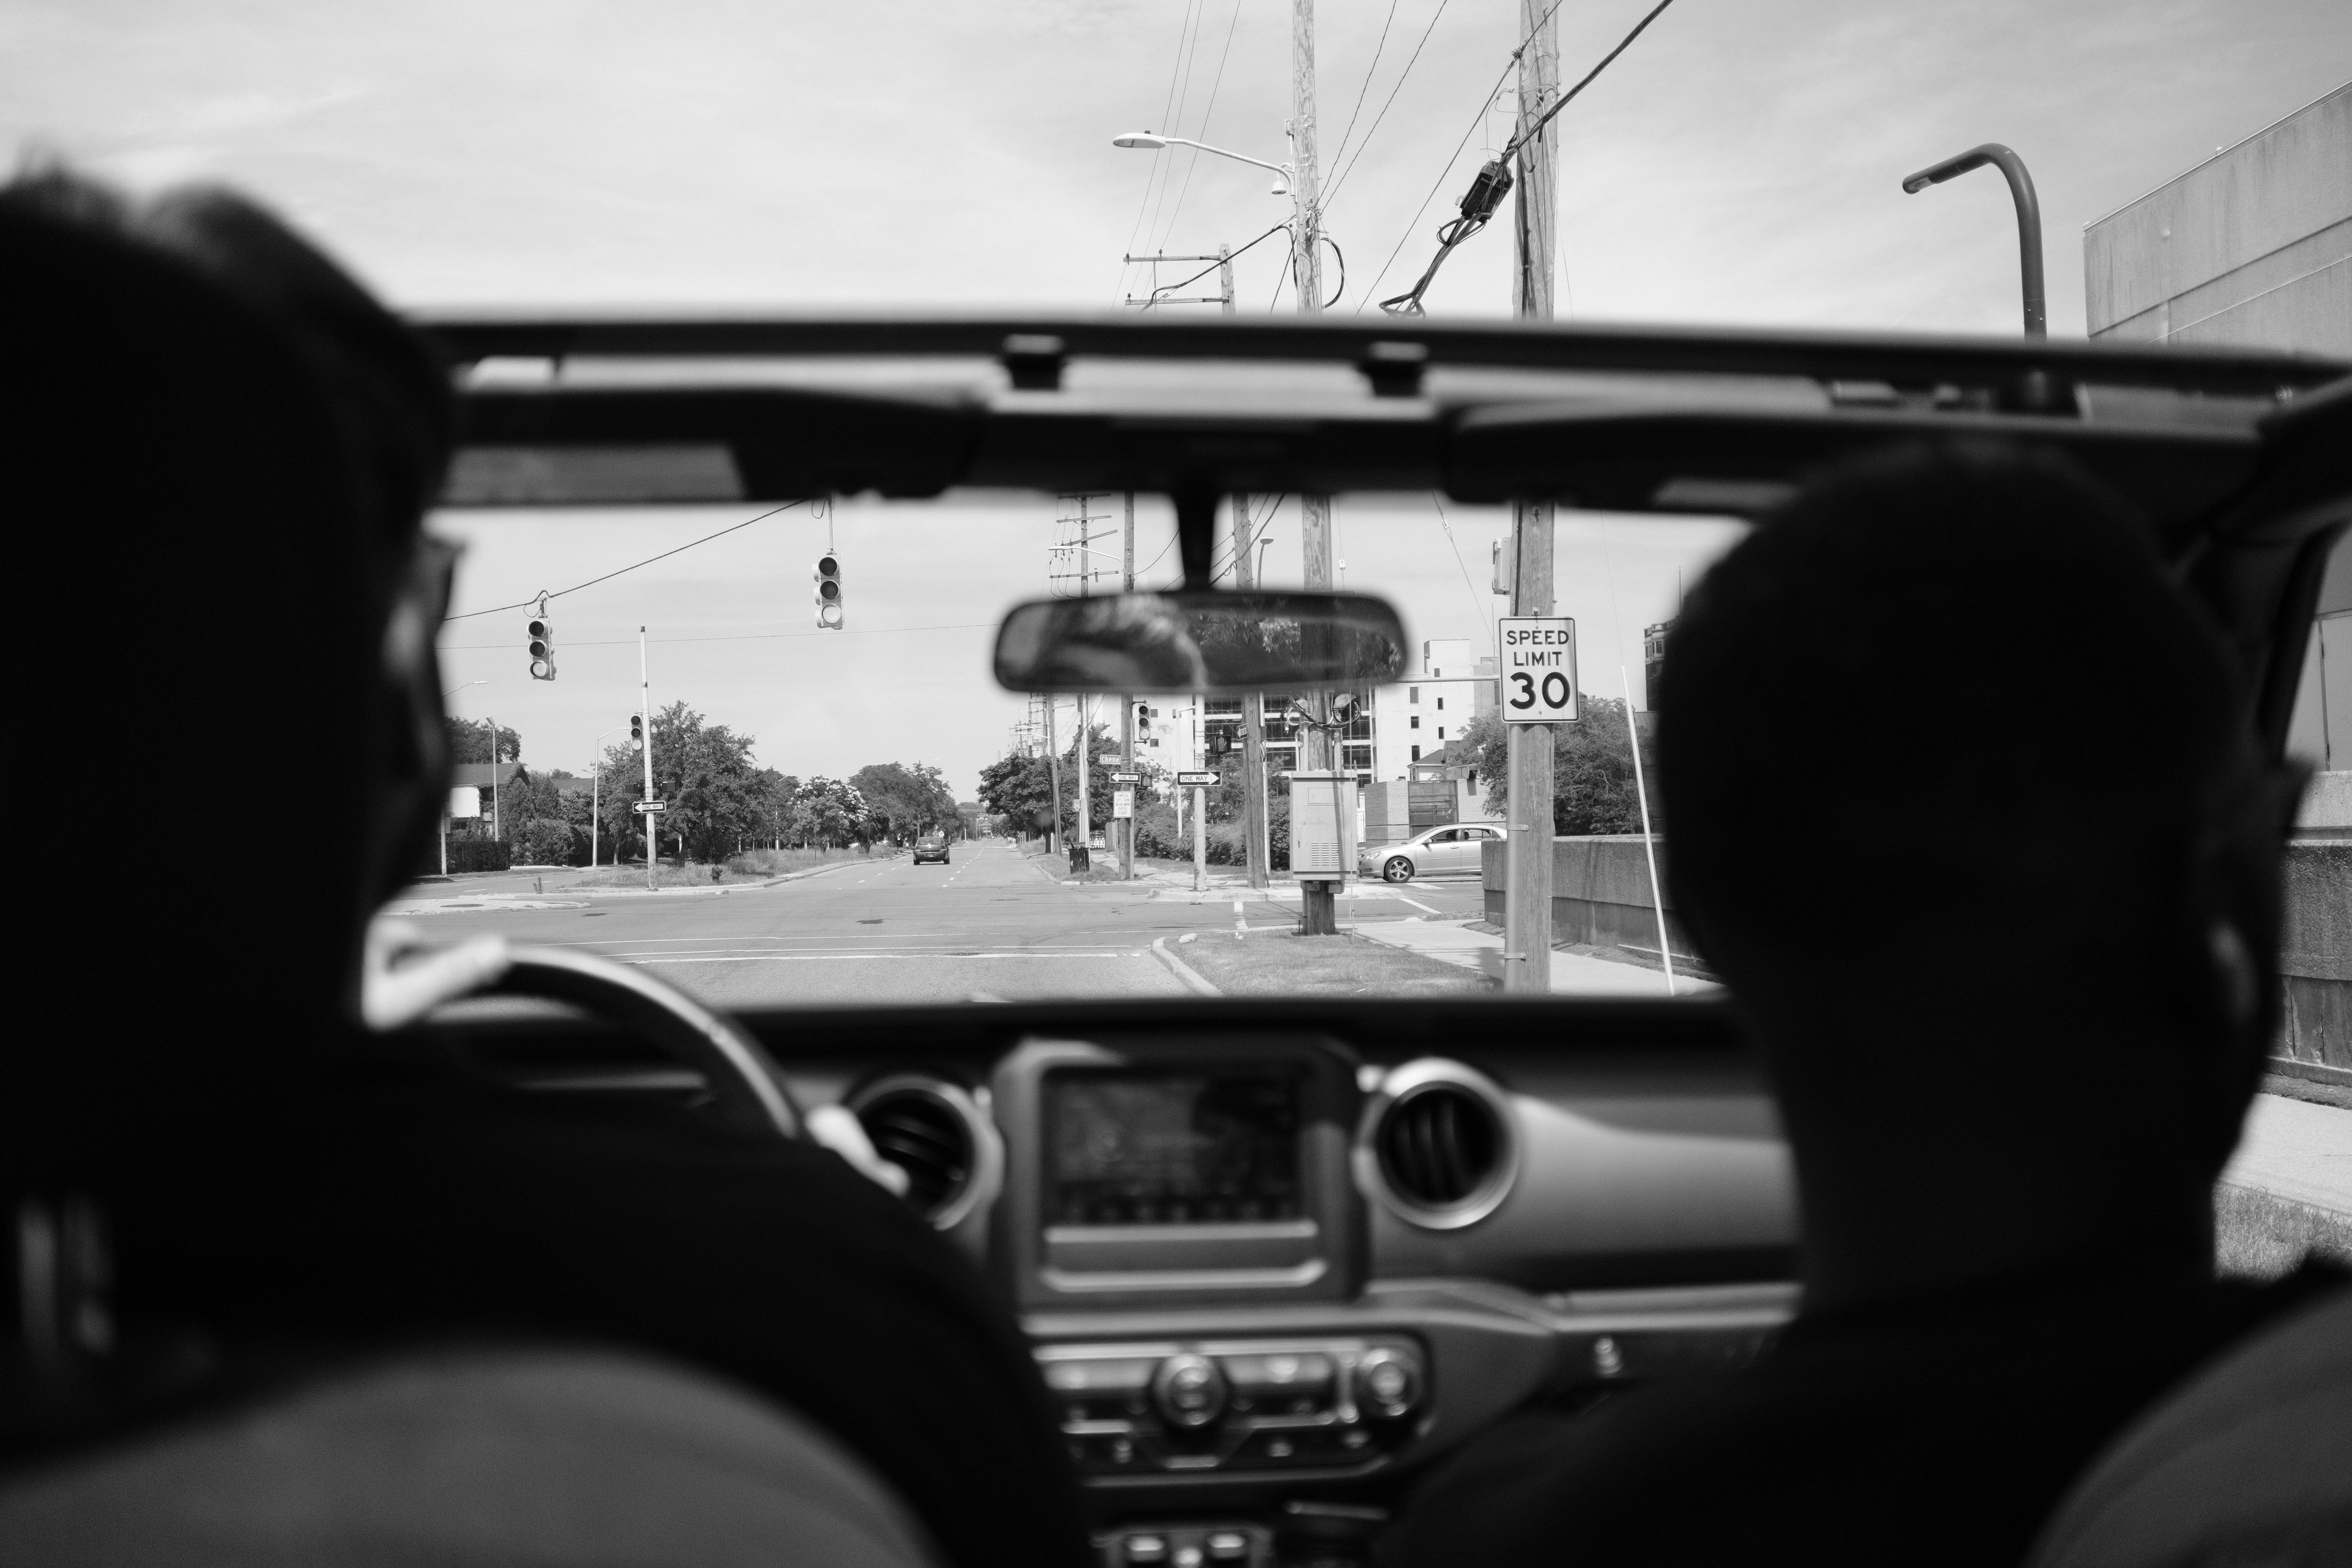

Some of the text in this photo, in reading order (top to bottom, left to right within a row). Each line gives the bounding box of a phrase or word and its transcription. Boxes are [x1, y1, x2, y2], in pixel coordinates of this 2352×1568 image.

[1506, 630, 1570, 645] SPEED
[1514, 651, 1562, 666] LIMIT
[1509, 672, 1571, 709] 30
